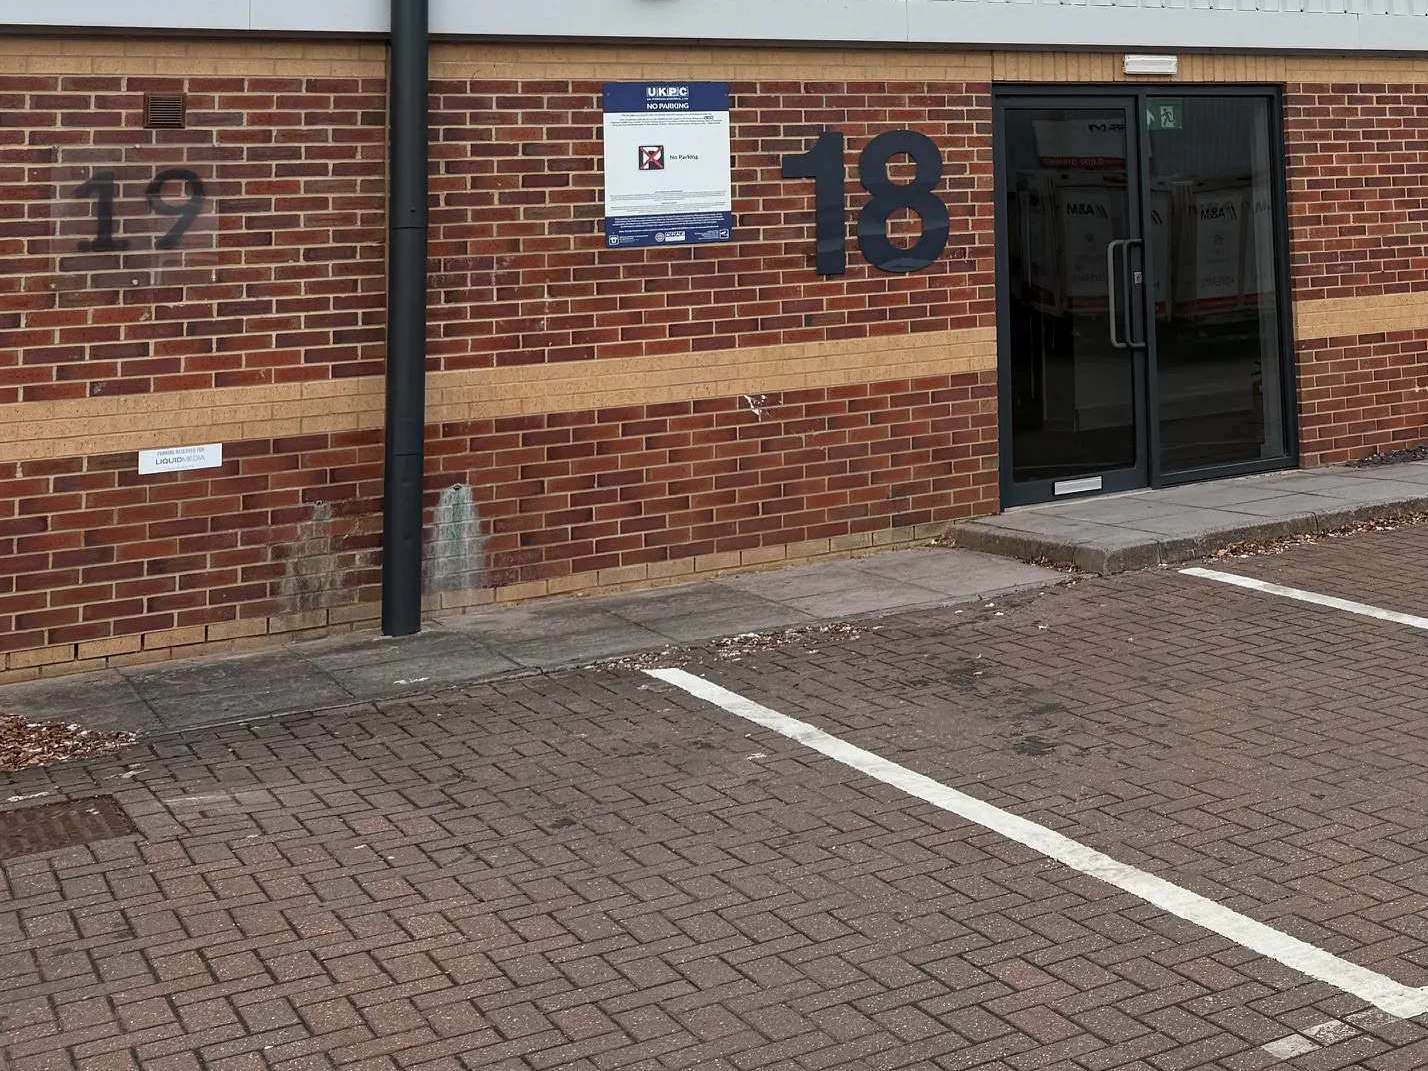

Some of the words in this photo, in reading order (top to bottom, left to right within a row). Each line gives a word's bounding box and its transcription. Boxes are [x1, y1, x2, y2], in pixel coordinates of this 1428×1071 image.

[646, 86, 689, 98] UKPC
[659, 102, 690, 110] PARKING
[73, 168, 206, 252] 19
[782, 129, 950, 275] 18
